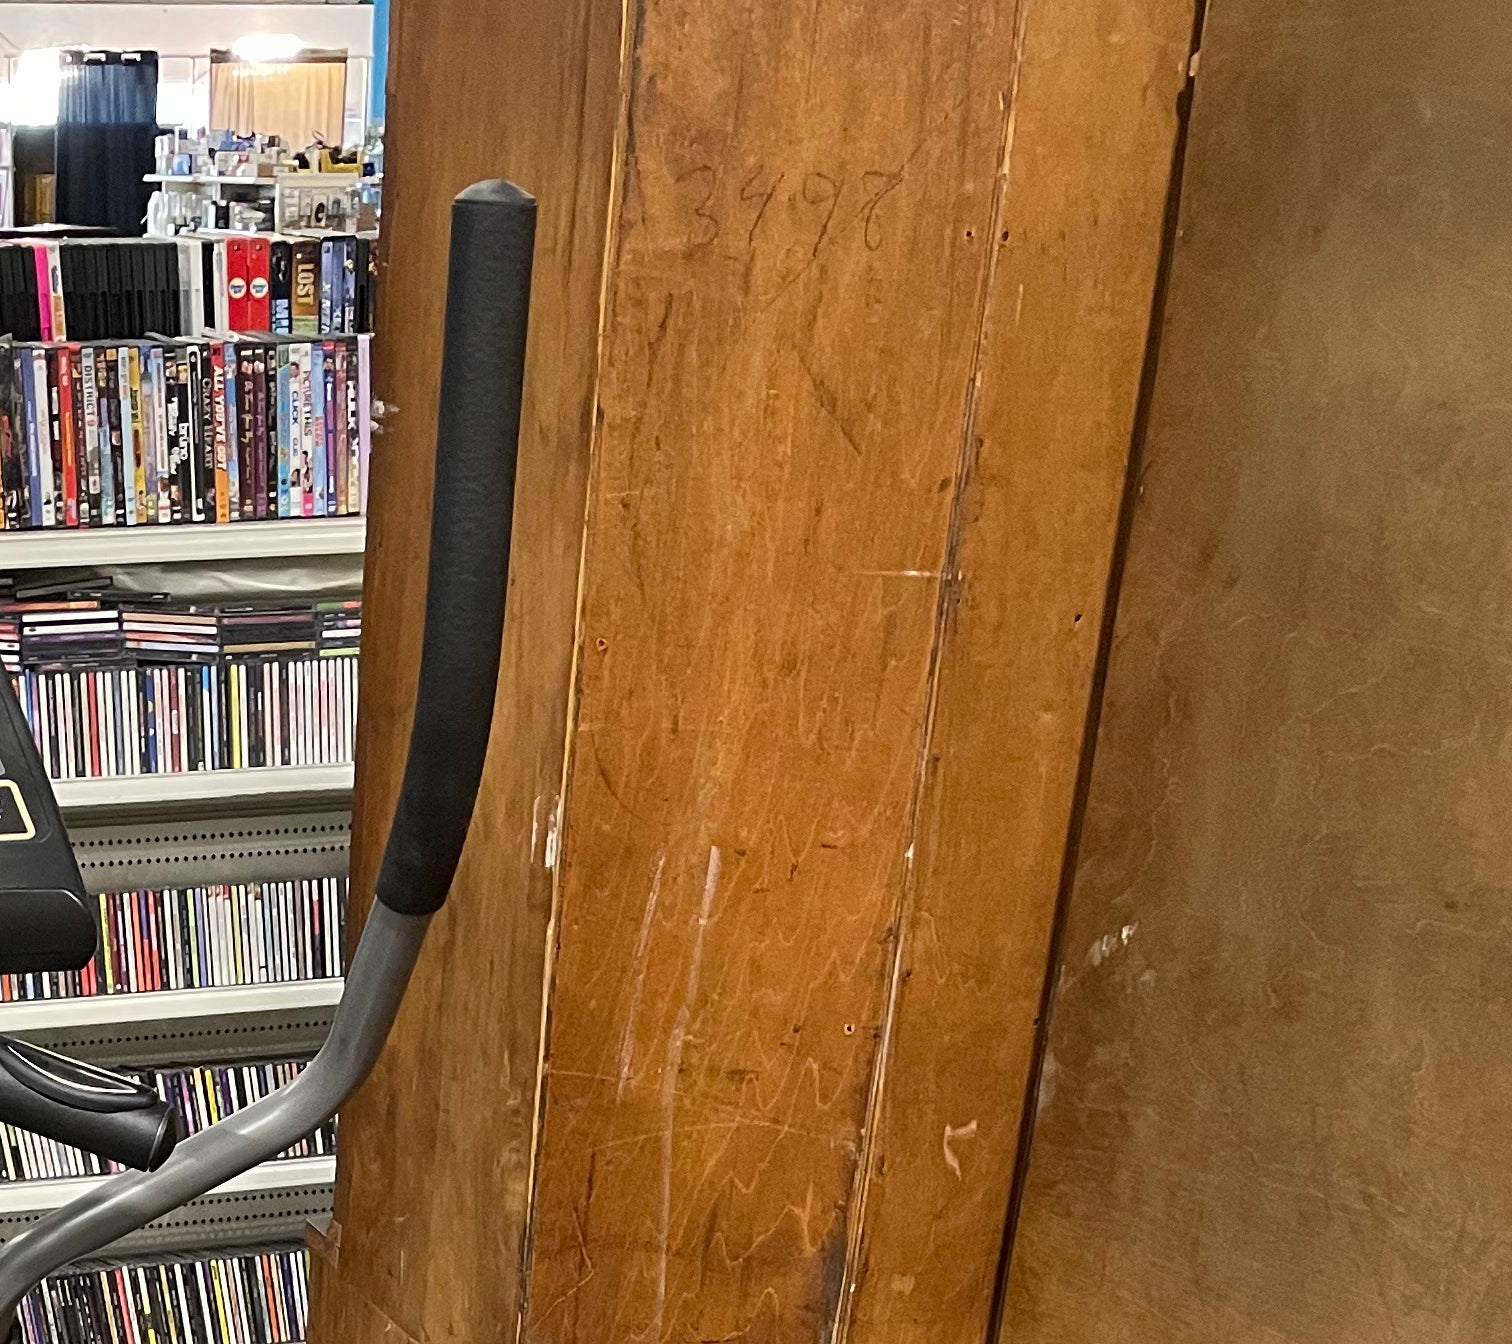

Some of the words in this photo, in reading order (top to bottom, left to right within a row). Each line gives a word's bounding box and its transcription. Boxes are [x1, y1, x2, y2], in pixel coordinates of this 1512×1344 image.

[296, 263, 315, 305] LOST
[84, 365, 98, 419] DISTRICT
[213, 365, 224, 391] ALL
[291, 390, 299, 425] CLICK
